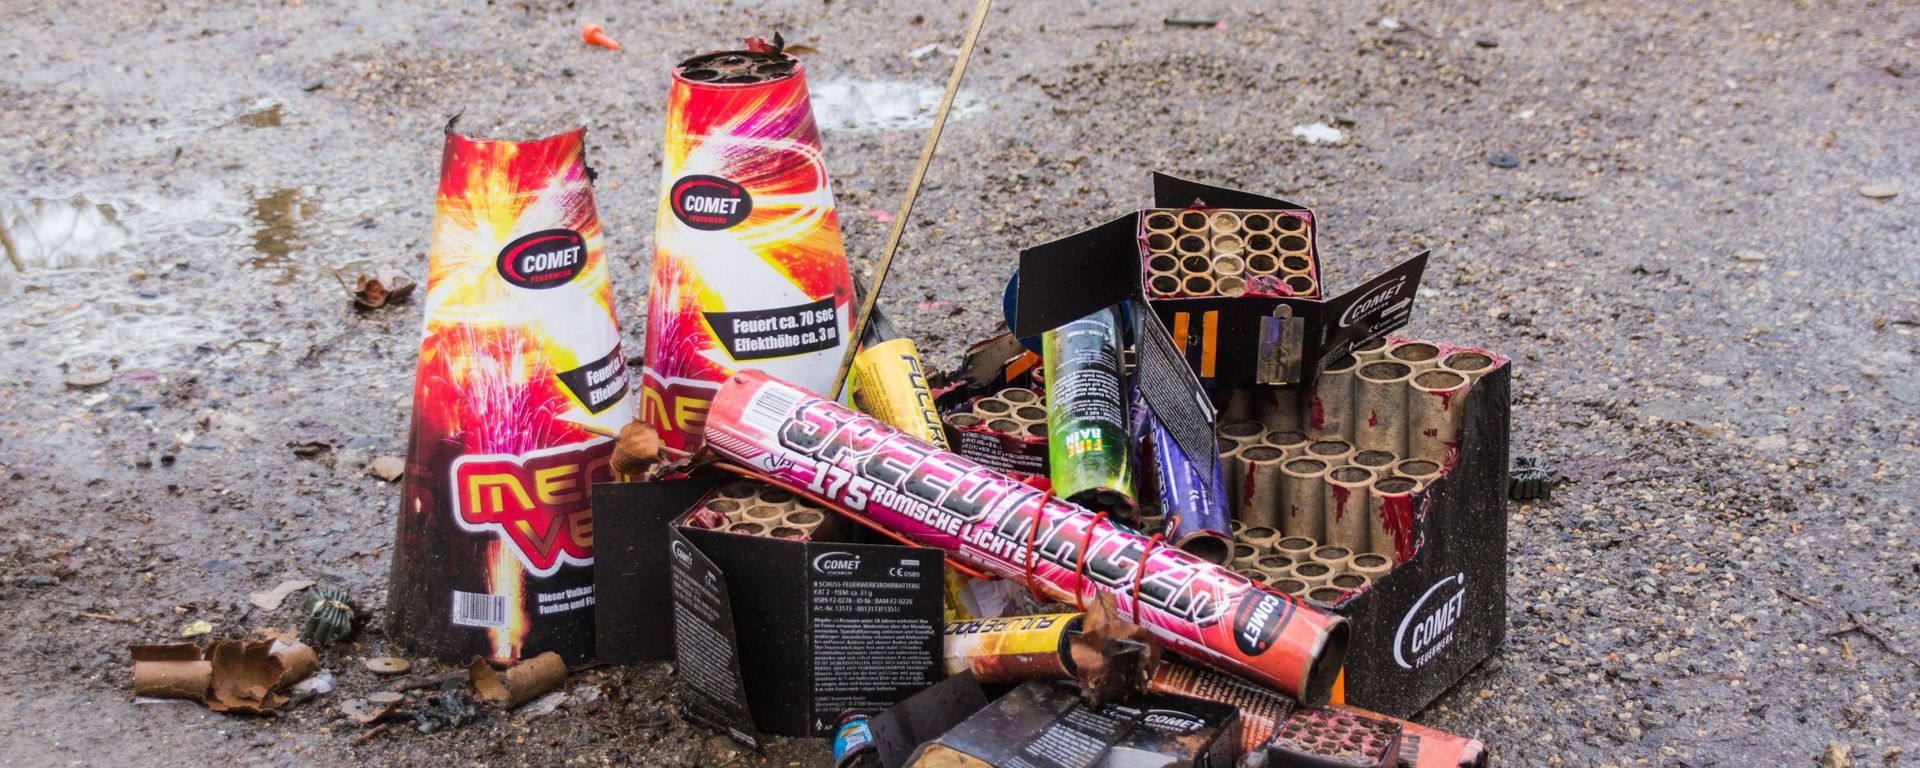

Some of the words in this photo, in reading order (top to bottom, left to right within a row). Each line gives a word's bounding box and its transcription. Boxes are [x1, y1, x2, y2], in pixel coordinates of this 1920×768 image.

[685, 195, 741, 214] COMET
[523, 246, 580, 273] COMET
[1352, 281, 1406, 319] COMET
[733, 317, 778, 333] Feuert
[780, 315, 799, 329] ca.
[800, 310, 814, 326] 70
[816, 308, 834, 323] sec
[735, 333, 800, 352] Effekthöhe
[802, 332, 818, 345] ca.
[819, 327, 826, 341] 3
[827, 326, 836, 339] m
[1065, 427, 1102, 445] RAIN
[1067, 439, 1103, 458] FIRE
[778, 399, 1014, 522] SPEED
[996, 489, 1252, 625] RACER
[807, 461, 875, 511] 175
[962, 523, 1040, 568] LICHTER
[824, 560, 861, 570] COMET
[538, 592, 566, 603] Dieser
[566, 585, 592, 599] Vulkan
[540, 603, 569, 615] Funken
[571, 598, 585, 609] und
[1243, 595, 1279, 647] COMET
[1411, 587, 1465, 653] COMET
[1416, 631, 1453, 668] FEUERWERK
[1144, 714, 1205, 731] COMET
